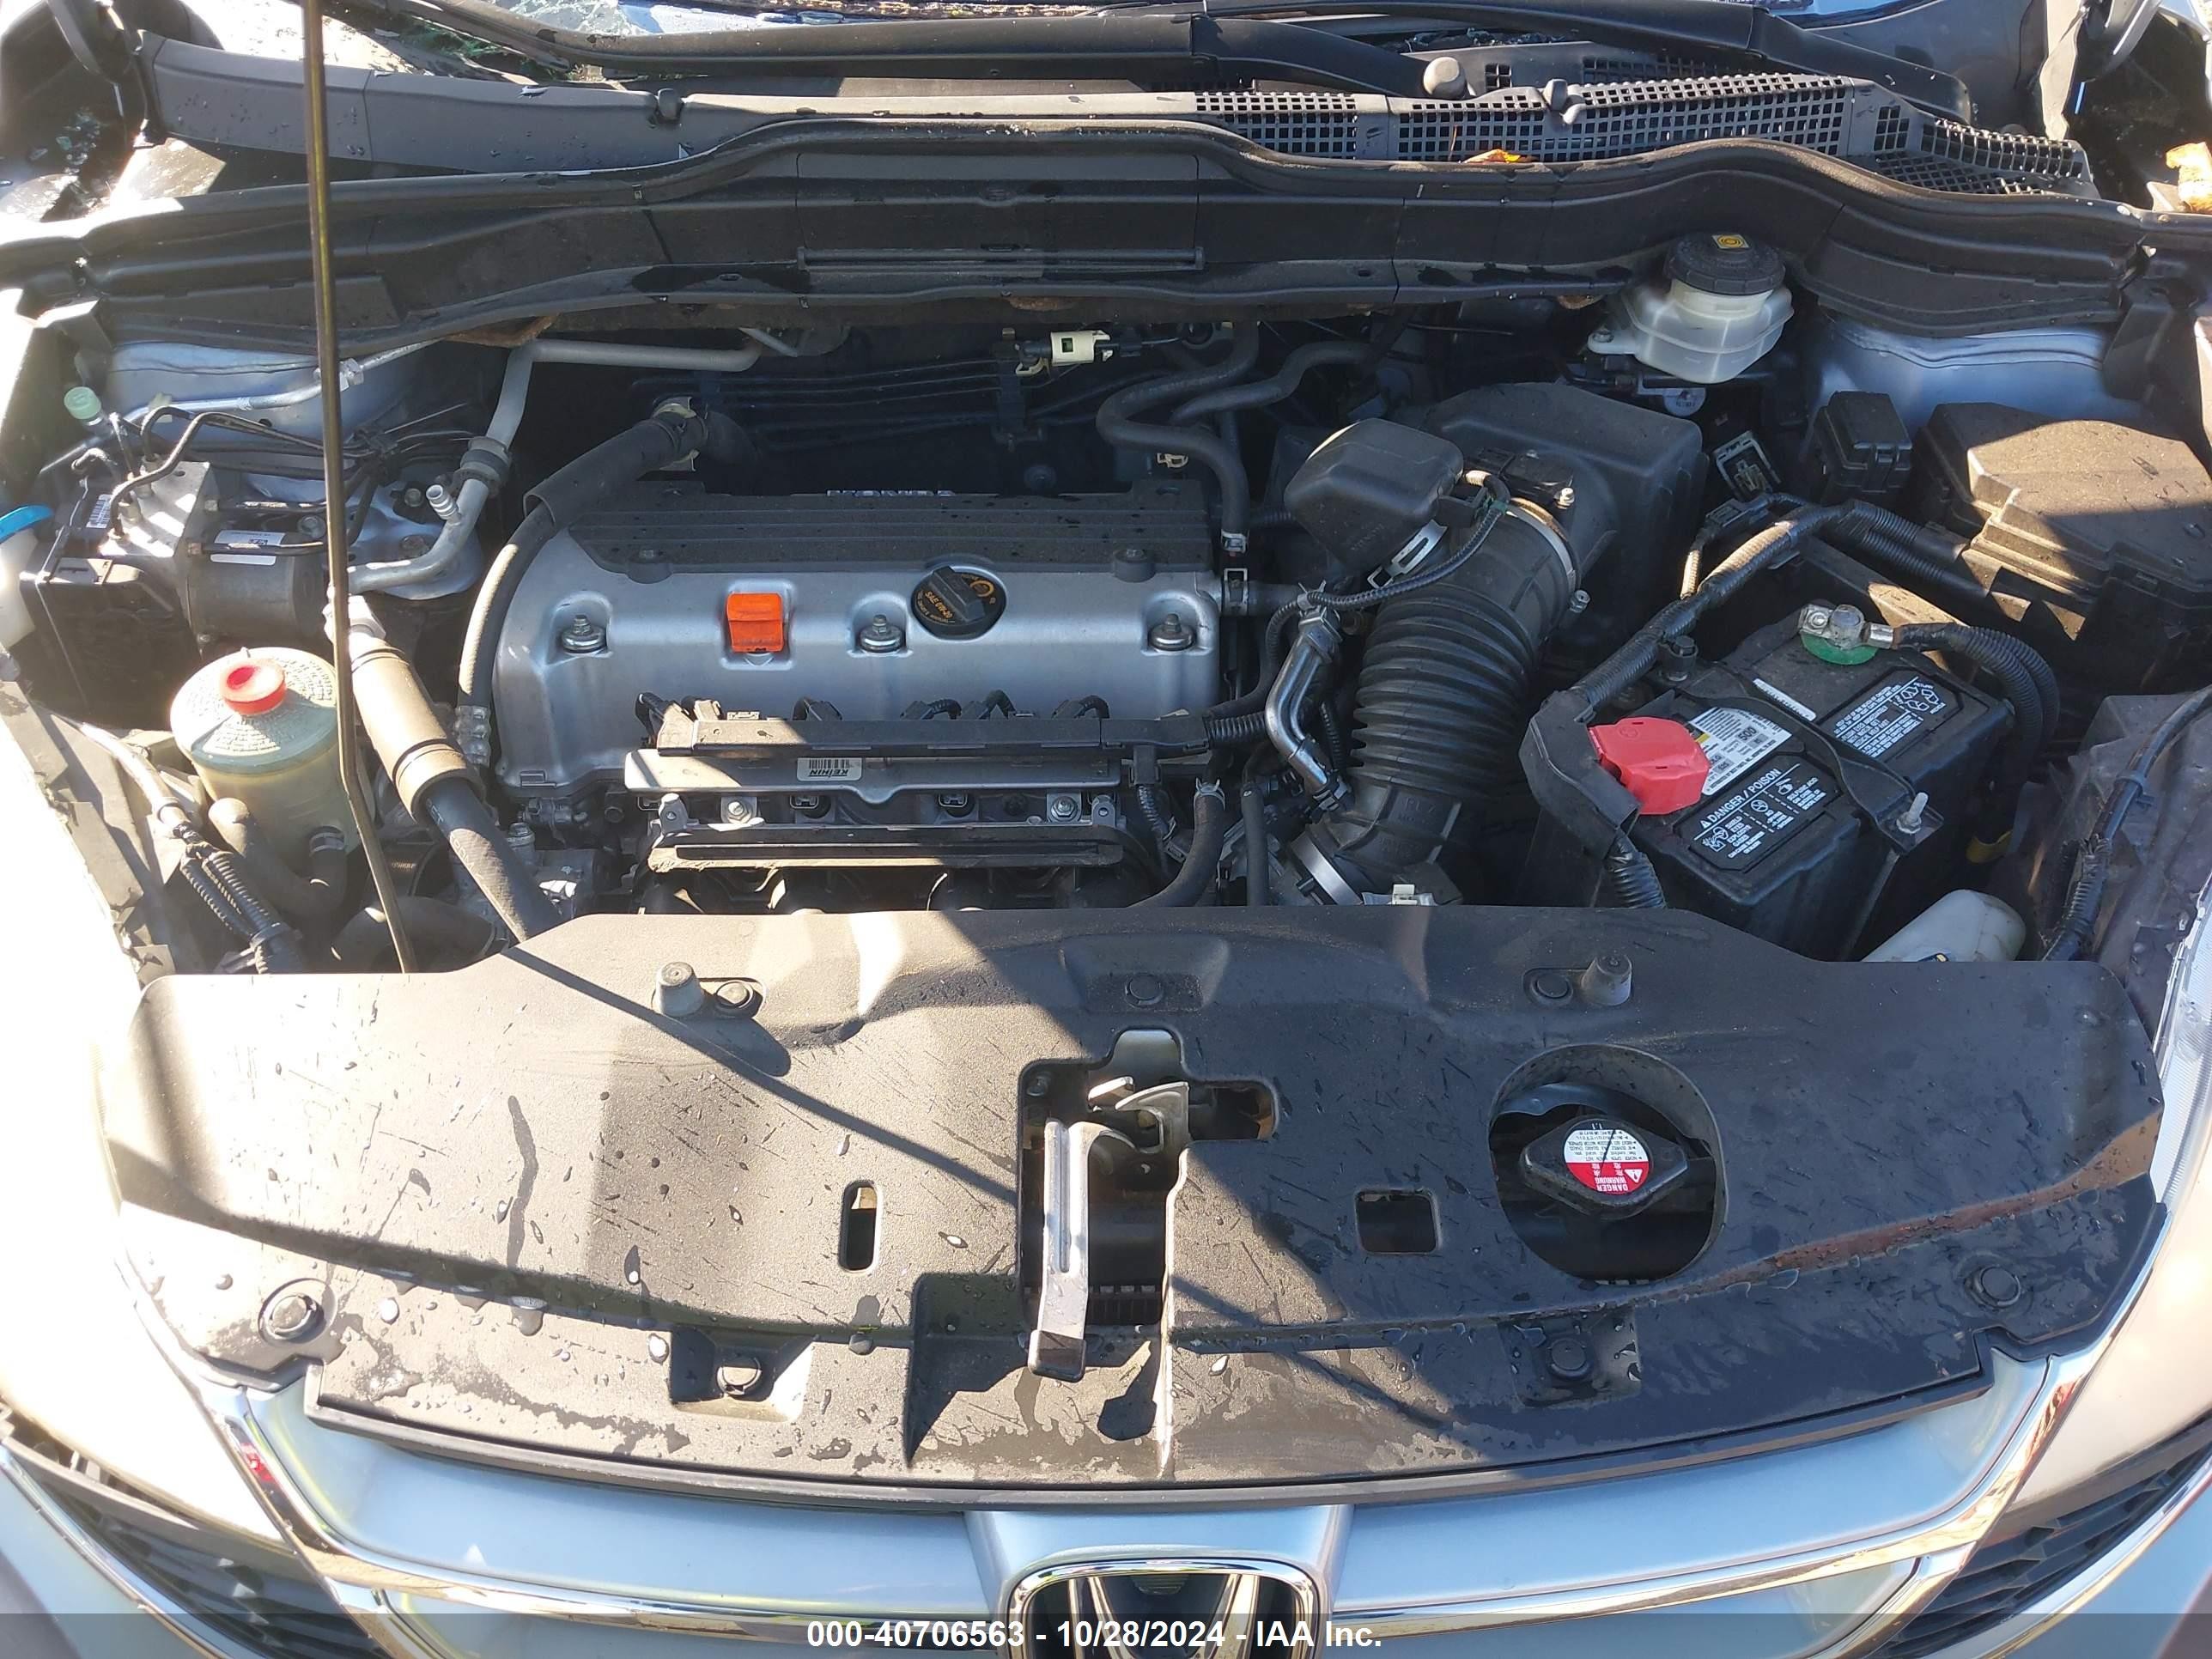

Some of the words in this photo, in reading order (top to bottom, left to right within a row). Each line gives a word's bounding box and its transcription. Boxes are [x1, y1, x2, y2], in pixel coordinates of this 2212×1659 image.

[926, 591, 939, 605] SAE
[1737, 725, 1757, 741] 500
[1708, 794, 1744, 823] DANGER
[1747, 768, 1781, 793] POISON
